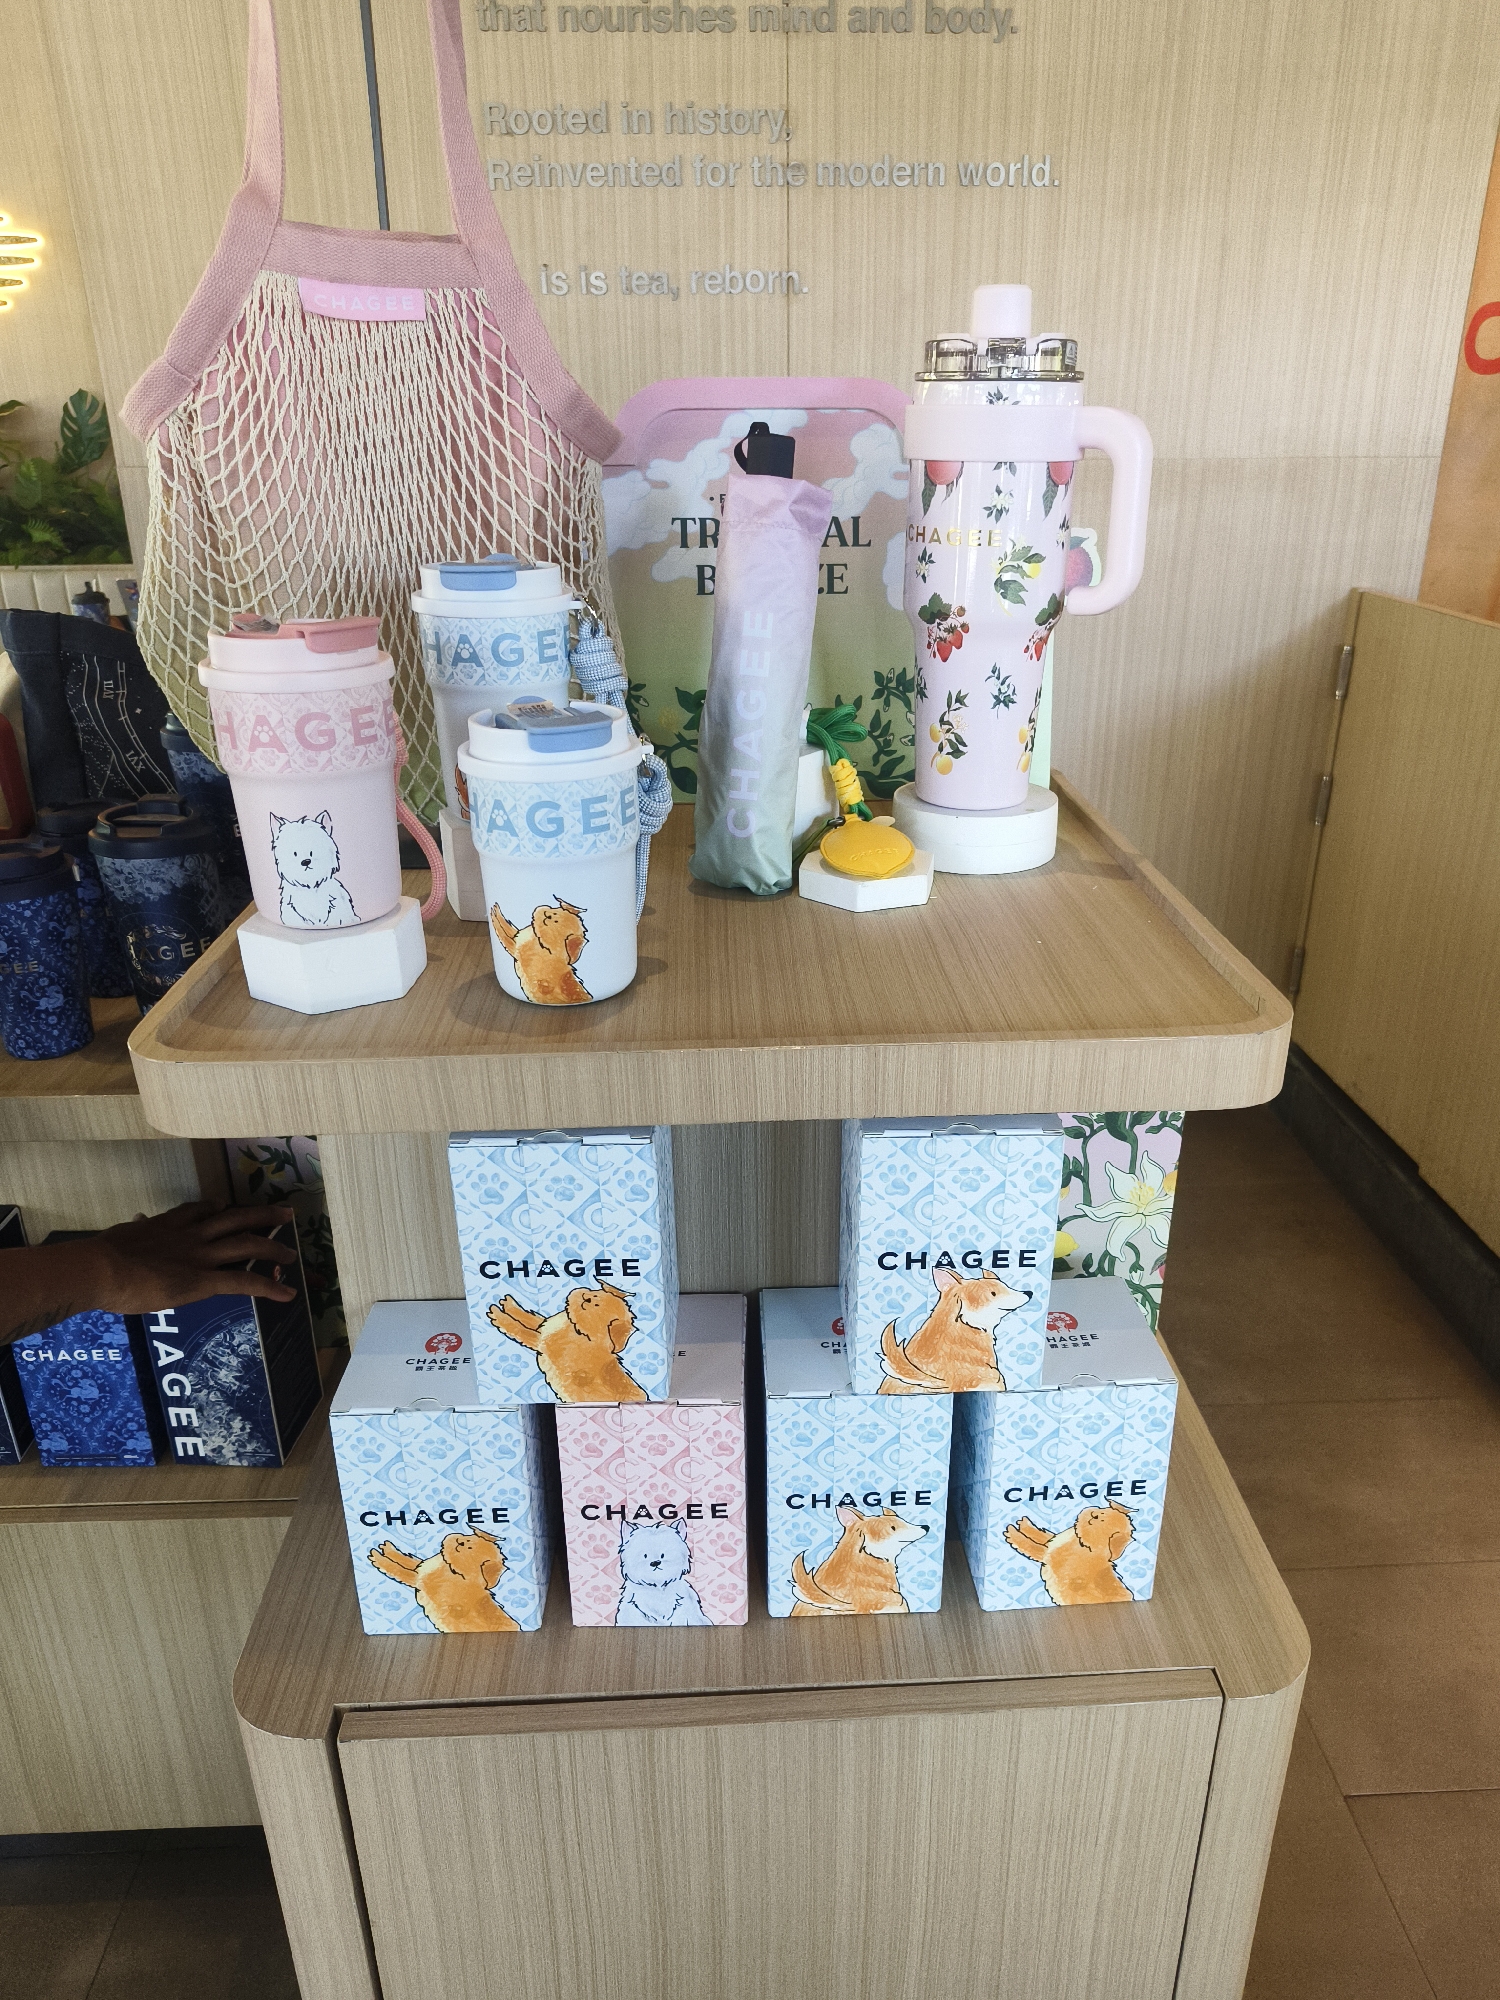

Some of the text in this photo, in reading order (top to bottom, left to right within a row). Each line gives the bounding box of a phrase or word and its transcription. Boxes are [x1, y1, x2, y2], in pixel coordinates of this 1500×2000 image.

[475, 0, 1018, 43] that nourishes mind and body.
[483, 101, 793, 143] Rooted in history,
[487, 154, 1060, 190] Reinvented for the modern world.
[540, 263, 809, 301] is is tea, reborn.
[314, 294, 415, 311] CHAGEE
[907, 523, 1004, 547] CHAGEE
[726, 610, 774, 839] CHAGEE
[479, 1258, 641, 1279] CHAGEE
[877, 1249, 1038, 1271] CHAGEE
[21, 1349, 122, 1361] CHAGEE
[405, 1357, 472, 1365] CHAGEE
[785, 1489, 932, 1510] CHAGEE
[1003, 1479, 1147, 1503] CHAGEE
[359, 1506, 510, 1527] CHAGEE
[580, 1502, 729, 1522] CHAGEE
